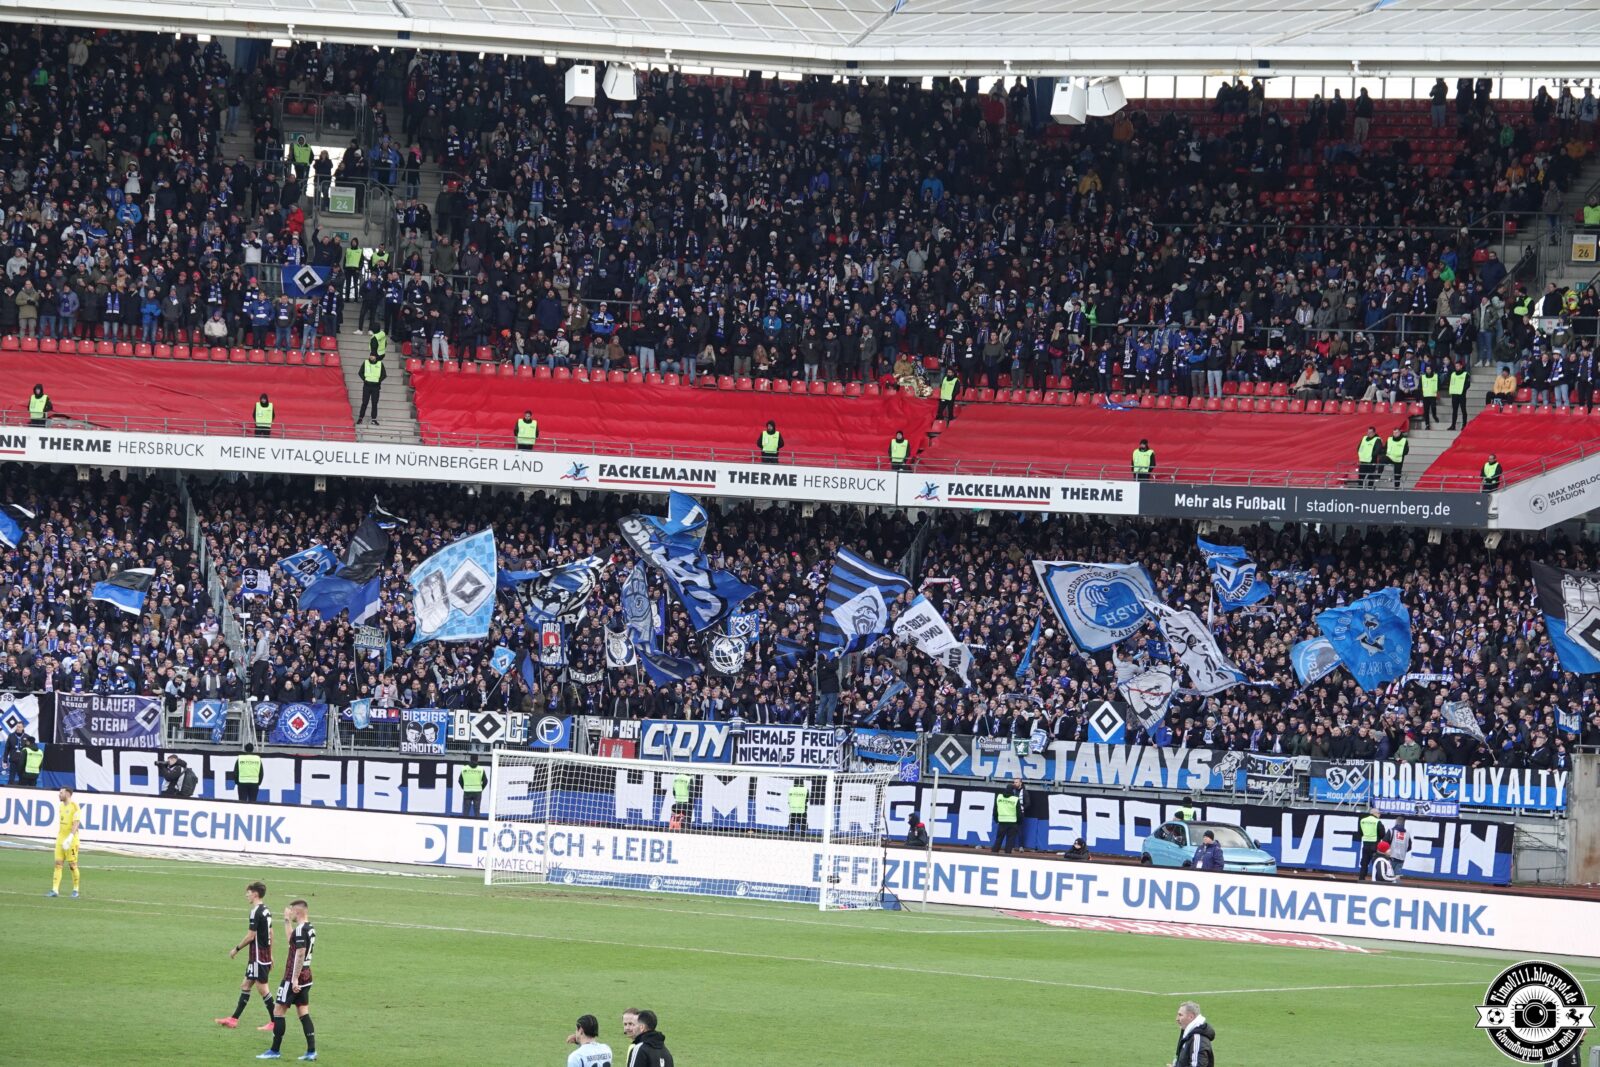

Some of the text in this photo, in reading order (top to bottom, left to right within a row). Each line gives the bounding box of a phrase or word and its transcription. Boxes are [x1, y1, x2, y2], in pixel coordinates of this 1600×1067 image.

[336, 200, 348, 210] 24
[1578, 248, 1590, 258] 26
[39, 436, 111, 453] THERME
[118, 440, 204, 457] HERSBRUCK
[220, 445, 266, 460] MEINE
[271, 448, 370, 466] VITALQUELLE
[375, 453, 391, 465] IM
[395, 451, 499, 471] NÜRNBERGER
[598, 463, 886, 492] FACKELMANN THERME HERSBRUCK
[947, 482, 1123, 501] FACKELMANN THERME
[1548, 487, 1567, 499] MAX
[1550, 487, 1585, 506] STADION
[1174, 493, 1286, 511] Mehr als Fußball
[1306, 500, 1451, 518] stadion-nuernberg.de
[1101, 603, 1139, 626] HSV
[92, 697, 135, 712] BLAUER
[91, 717, 128, 732] STERN
[402, 710, 447, 722] BIERIGE
[619, 720, 641, 739] OST
[740, 730, 795, 746] NIEMALS
[401, 742, 444, 754] BANDITEN
[740, 747, 795, 763] NIEMALS
[971, 741, 1213, 789] CASTAWAYS
[1373, 760, 1429, 801] IRON
[1459, 765, 1567, 807] LOYALTY
[479, 823, 585, 858] DÖRSCH
[611, 836, 679, 864] LEIBL
[476, 856, 563, 872] KIMATECHNIK
[812, 853, 1000, 897] EFFIZIENTE
[1010, 868, 1109, 903] LUFT-
[1122, 876, 1200, 912] UND
[1212, 883, 1495, 936] KLIMATECHNIK.
